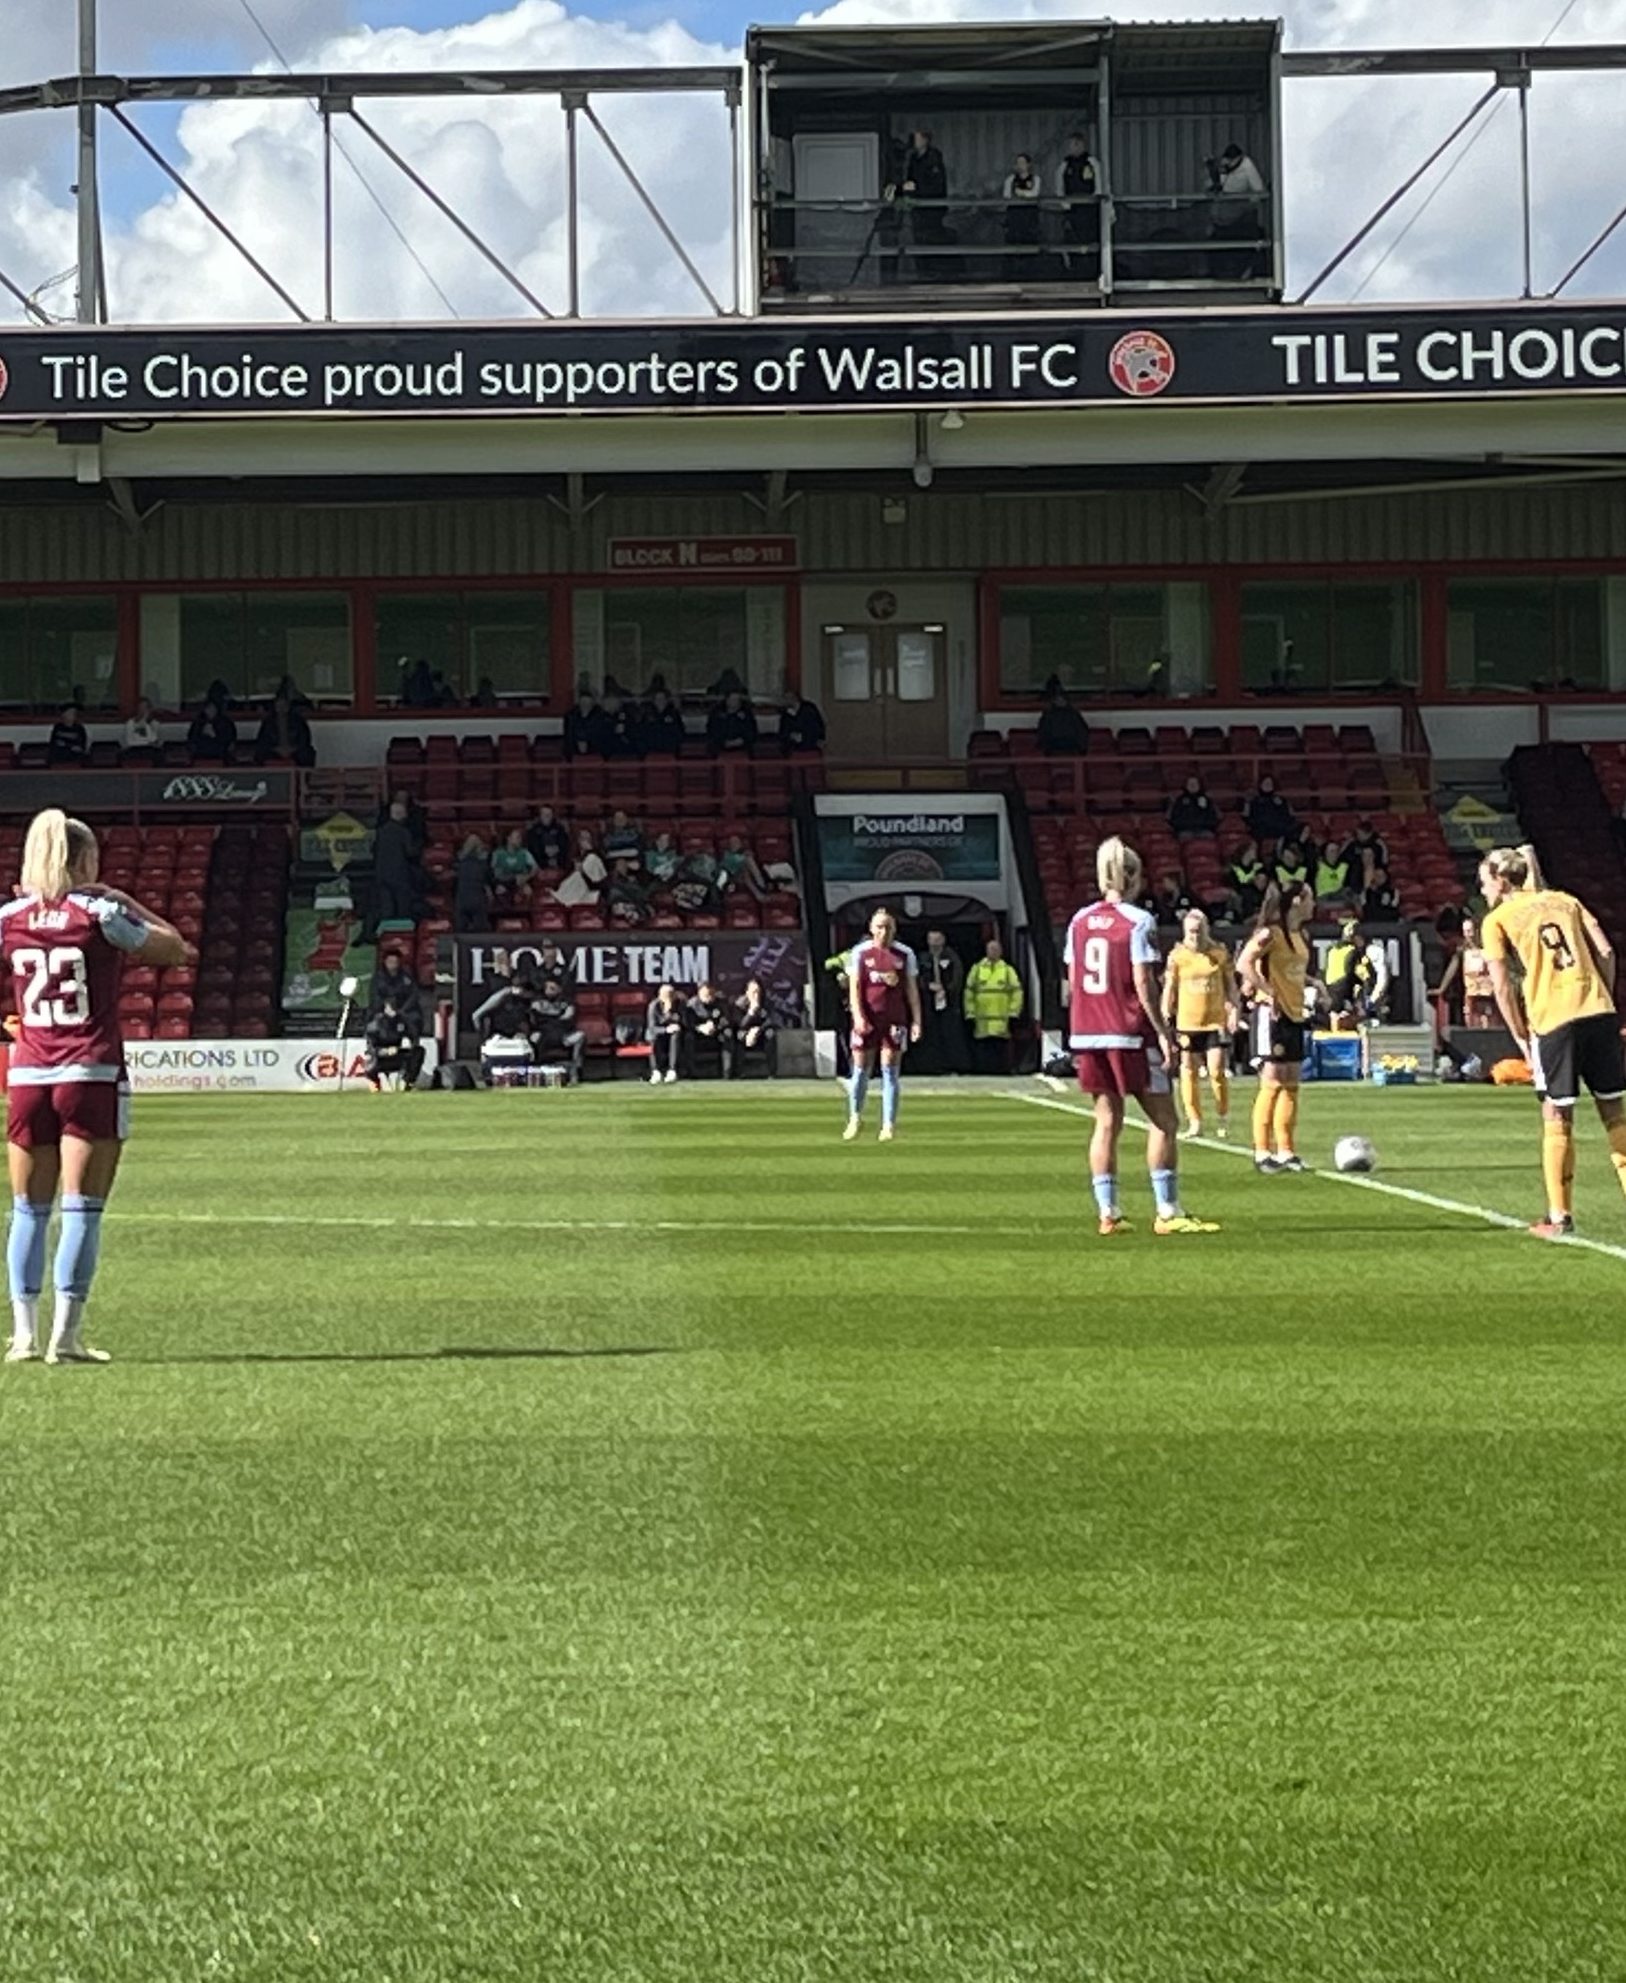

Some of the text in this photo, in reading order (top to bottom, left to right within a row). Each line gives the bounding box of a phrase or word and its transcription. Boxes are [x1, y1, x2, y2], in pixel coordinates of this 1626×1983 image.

[41, 354, 128, 399] Tile
[143, 353, 308, 398] Choice
[324, 351, 463, 406] proud
[480, 352, 738, 403] supporters
[754, 348, 805, 392] of
[817, 345, 992, 391] Walsall
[1011, 344, 1077, 388] FC
[1271, 327, 1626, 384] TILE CHOIC
[614, 548, 674, 566] BLOCK
[677, 542, 699, 566] N
[853, 813, 964, 833] Poundland
[623, 946, 709, 984] TEAM
[1083, 937, 1109, 995] 9
[1539, 922, 1576, 972] 9
[11, 946, 90, 1027] 23
[244, 1050, 280, 1067] LTD
